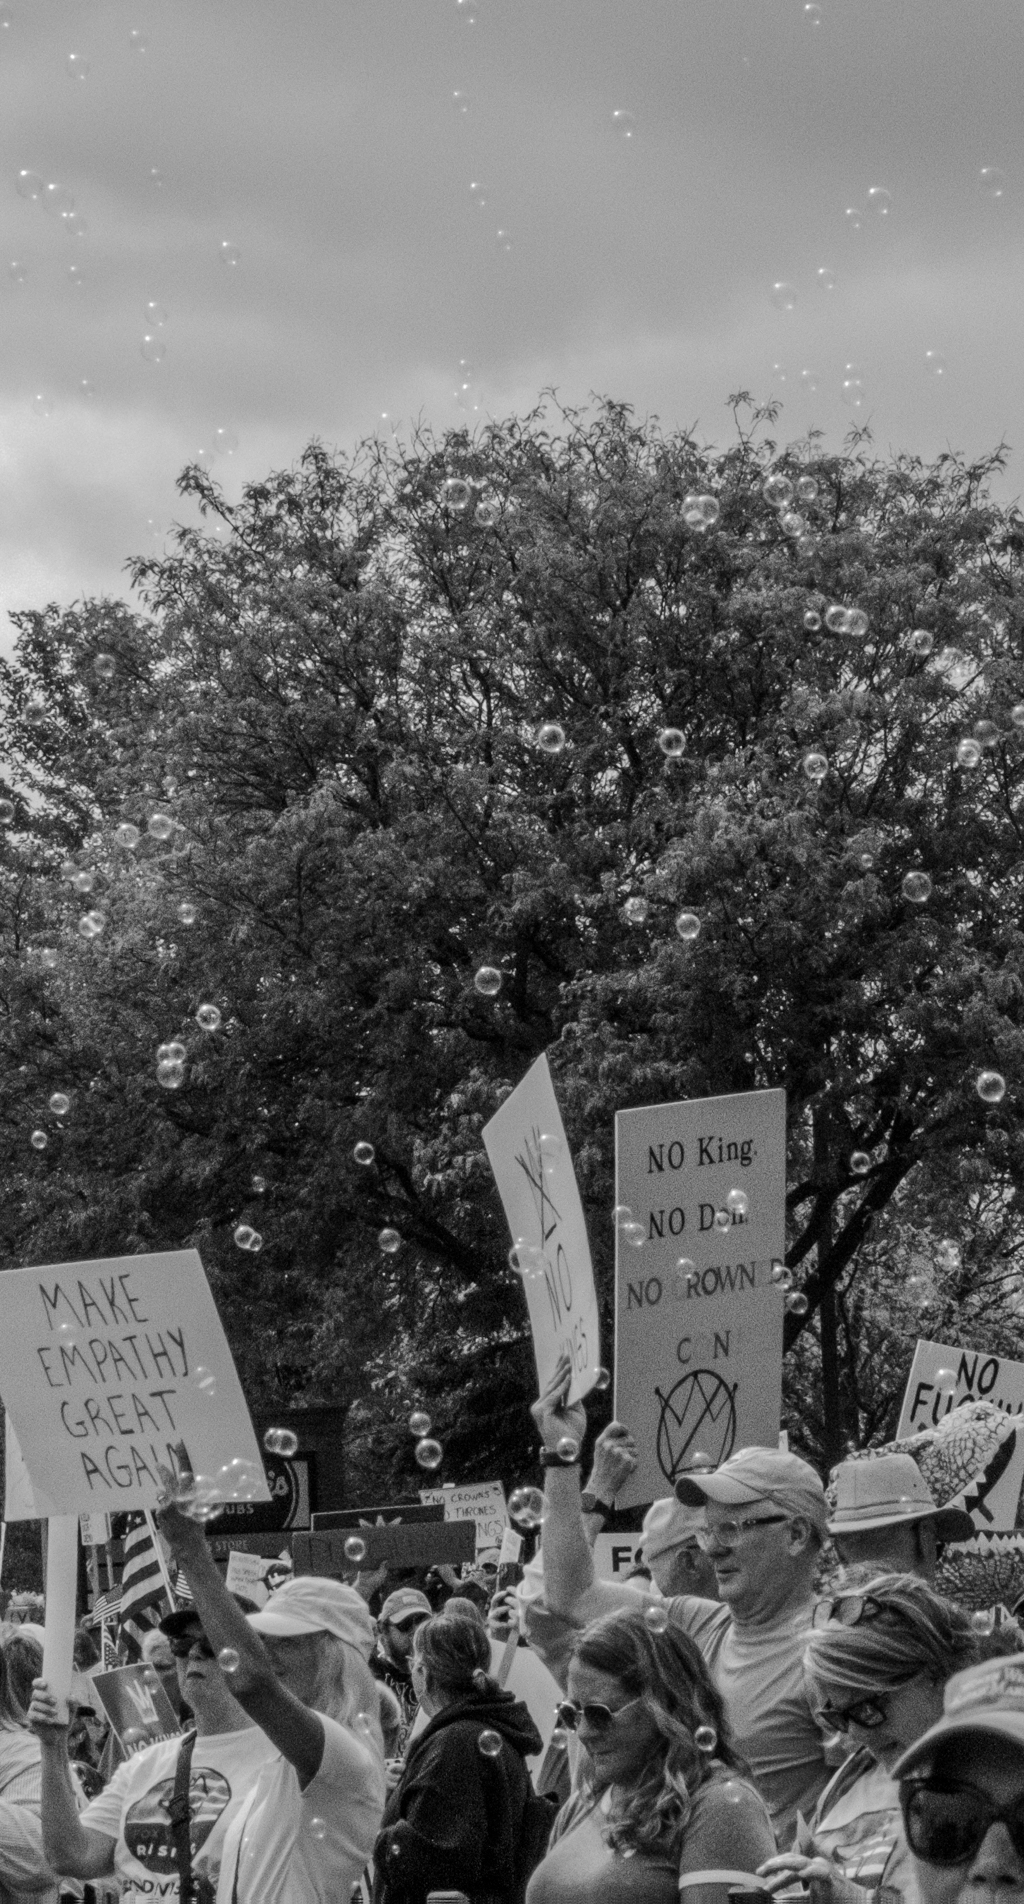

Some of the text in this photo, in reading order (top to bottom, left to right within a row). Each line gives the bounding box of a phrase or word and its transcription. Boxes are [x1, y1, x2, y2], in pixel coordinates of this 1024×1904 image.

[648, 1141, 685, 1174] NO
[648, 1207, 685, 1240] NO
[39, 1274, 149, 1330] MAKE
[626, 1278, 662, 1309] NO
[684, 1261, 756, 1299] ROWN
[37, 1327, 189, 1387] EMPATHY
[956, 1352, 1000, 1396] NO
[60, 1389, 177, 1438] GREAT
[477, 1514, 507, 1538] NGS!
[136, 1843, 197, 1858] RISIG
